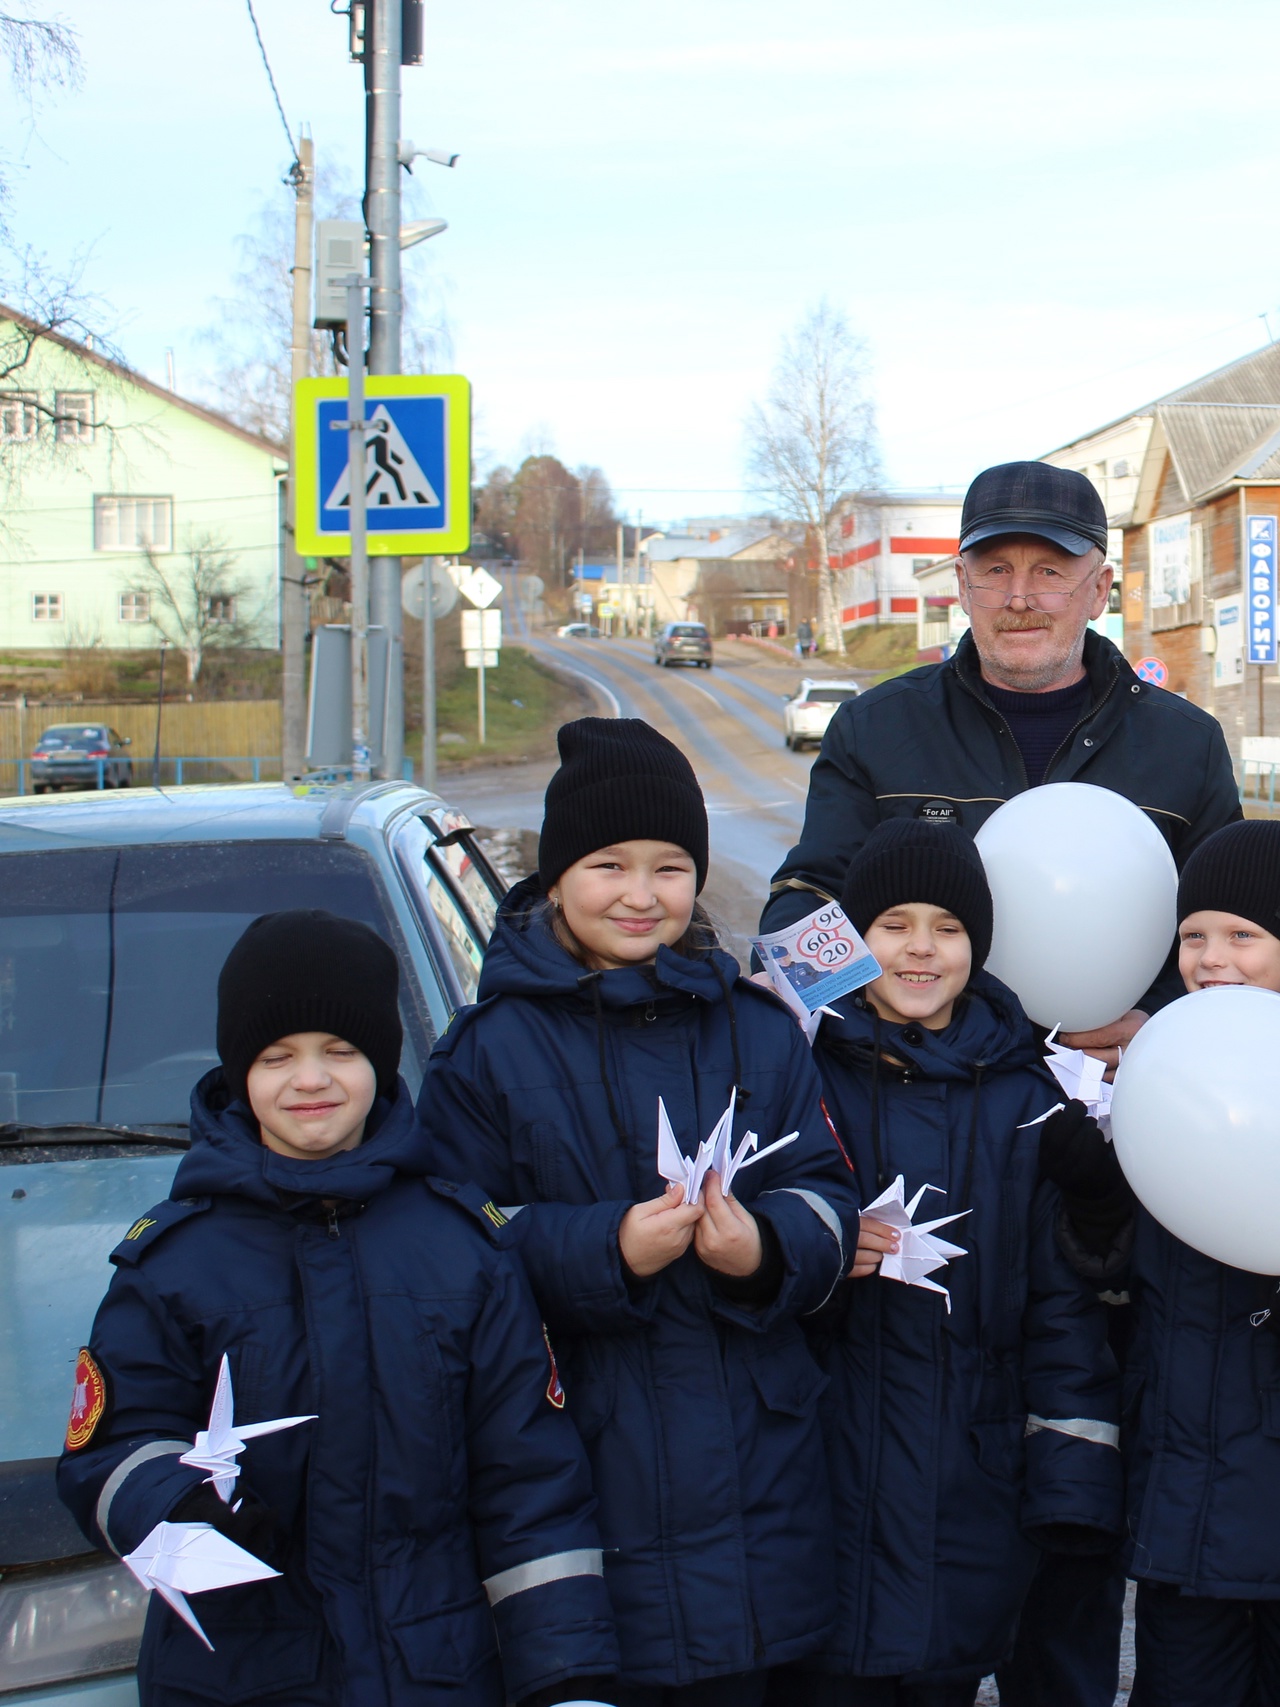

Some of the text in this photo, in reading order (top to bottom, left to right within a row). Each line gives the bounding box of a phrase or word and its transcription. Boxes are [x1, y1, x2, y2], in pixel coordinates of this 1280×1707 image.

[1251, 543, 1272, 660] ФАВОРИТ
[820, 906, 844, 927] 90
[807, 932, 831, 952] 60
[823, 942, 848, 963] 20
